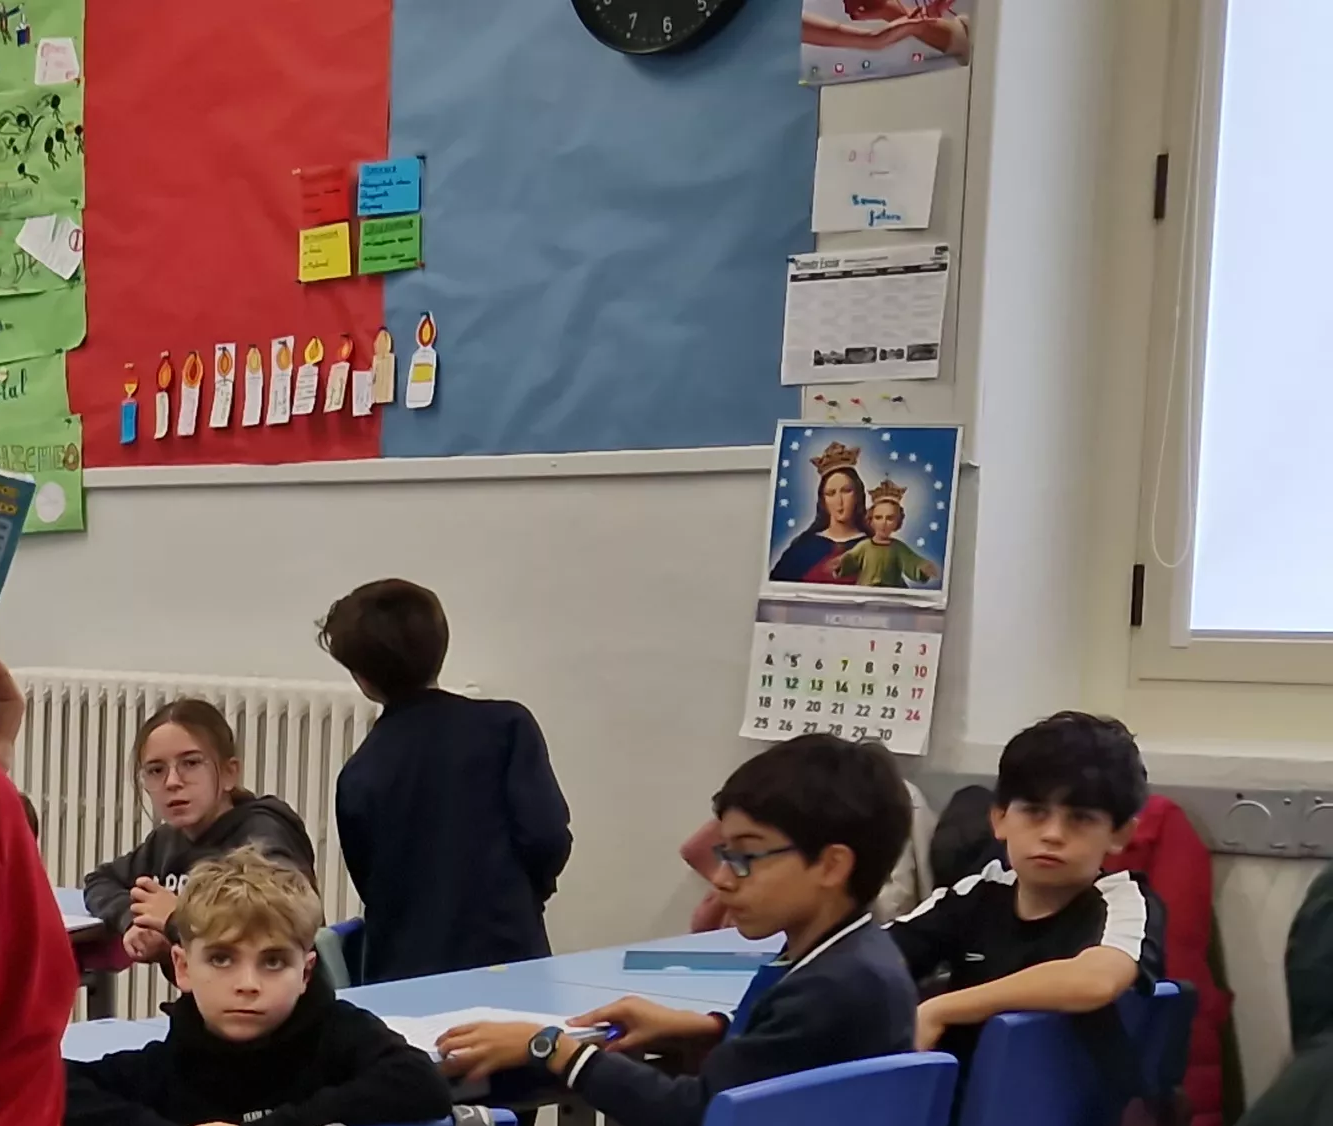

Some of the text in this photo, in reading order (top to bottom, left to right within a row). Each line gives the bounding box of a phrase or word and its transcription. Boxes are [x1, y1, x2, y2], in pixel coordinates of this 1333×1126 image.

[628, 12, 638, 31] 7
[662, 16, 673, 34] 6
[869, 640, 927, 656] 1 2 3
[765, 654, 928, 679] 4 5 6 7 8 9 10
[761, 674, 924, 700] 11 12 13 14 15 16 17
[759, 696, 921, 722] 18 19 20 21 22 23 24
[754, 717, 769, 730] 25
[778, 719, 793, 732] 26
[802, 722, 818, 734] 27
[851, 726, 868, 738] 29
